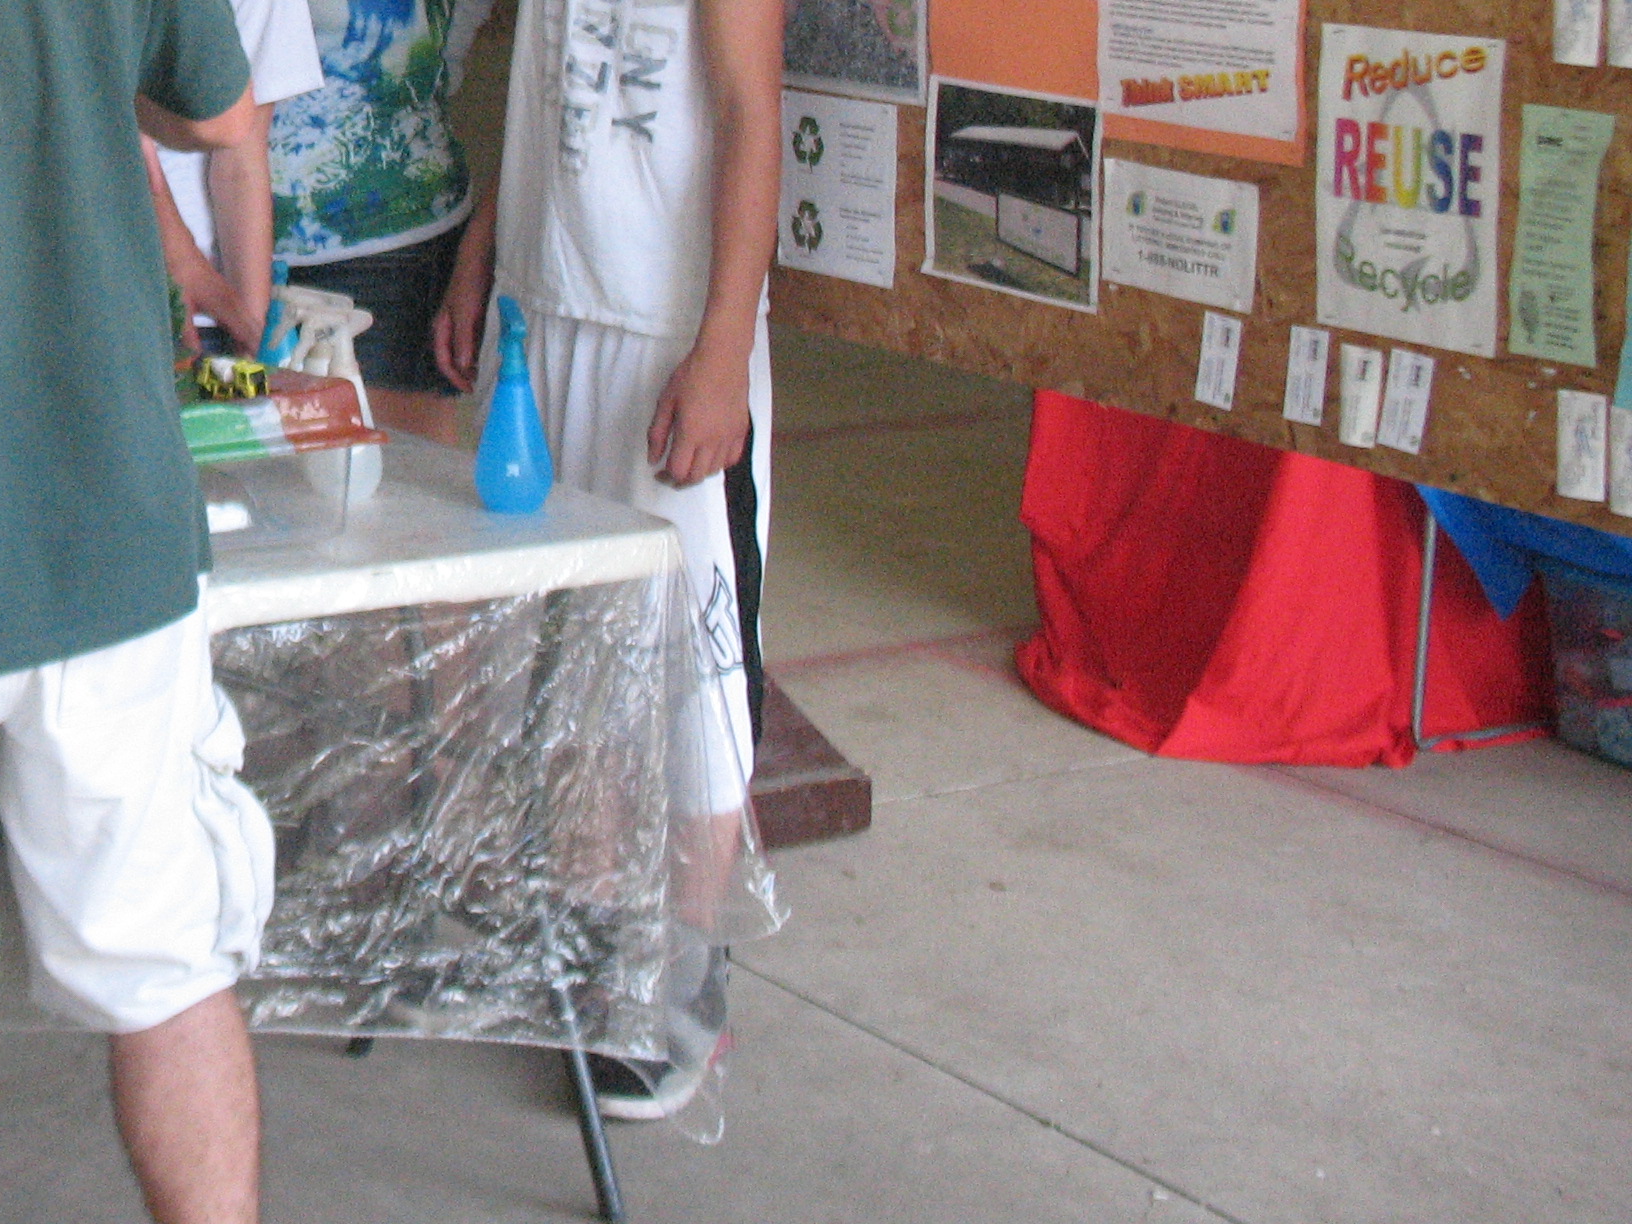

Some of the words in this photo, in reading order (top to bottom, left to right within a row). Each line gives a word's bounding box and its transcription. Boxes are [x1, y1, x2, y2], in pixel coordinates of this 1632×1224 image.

[1177, 68, 1271, 102] SMART
[1341, 45, 1488, 102] Reduce
[1333, 118, 1484, 218] REUSE
[1337, 234, 1471, 313] Recycle
